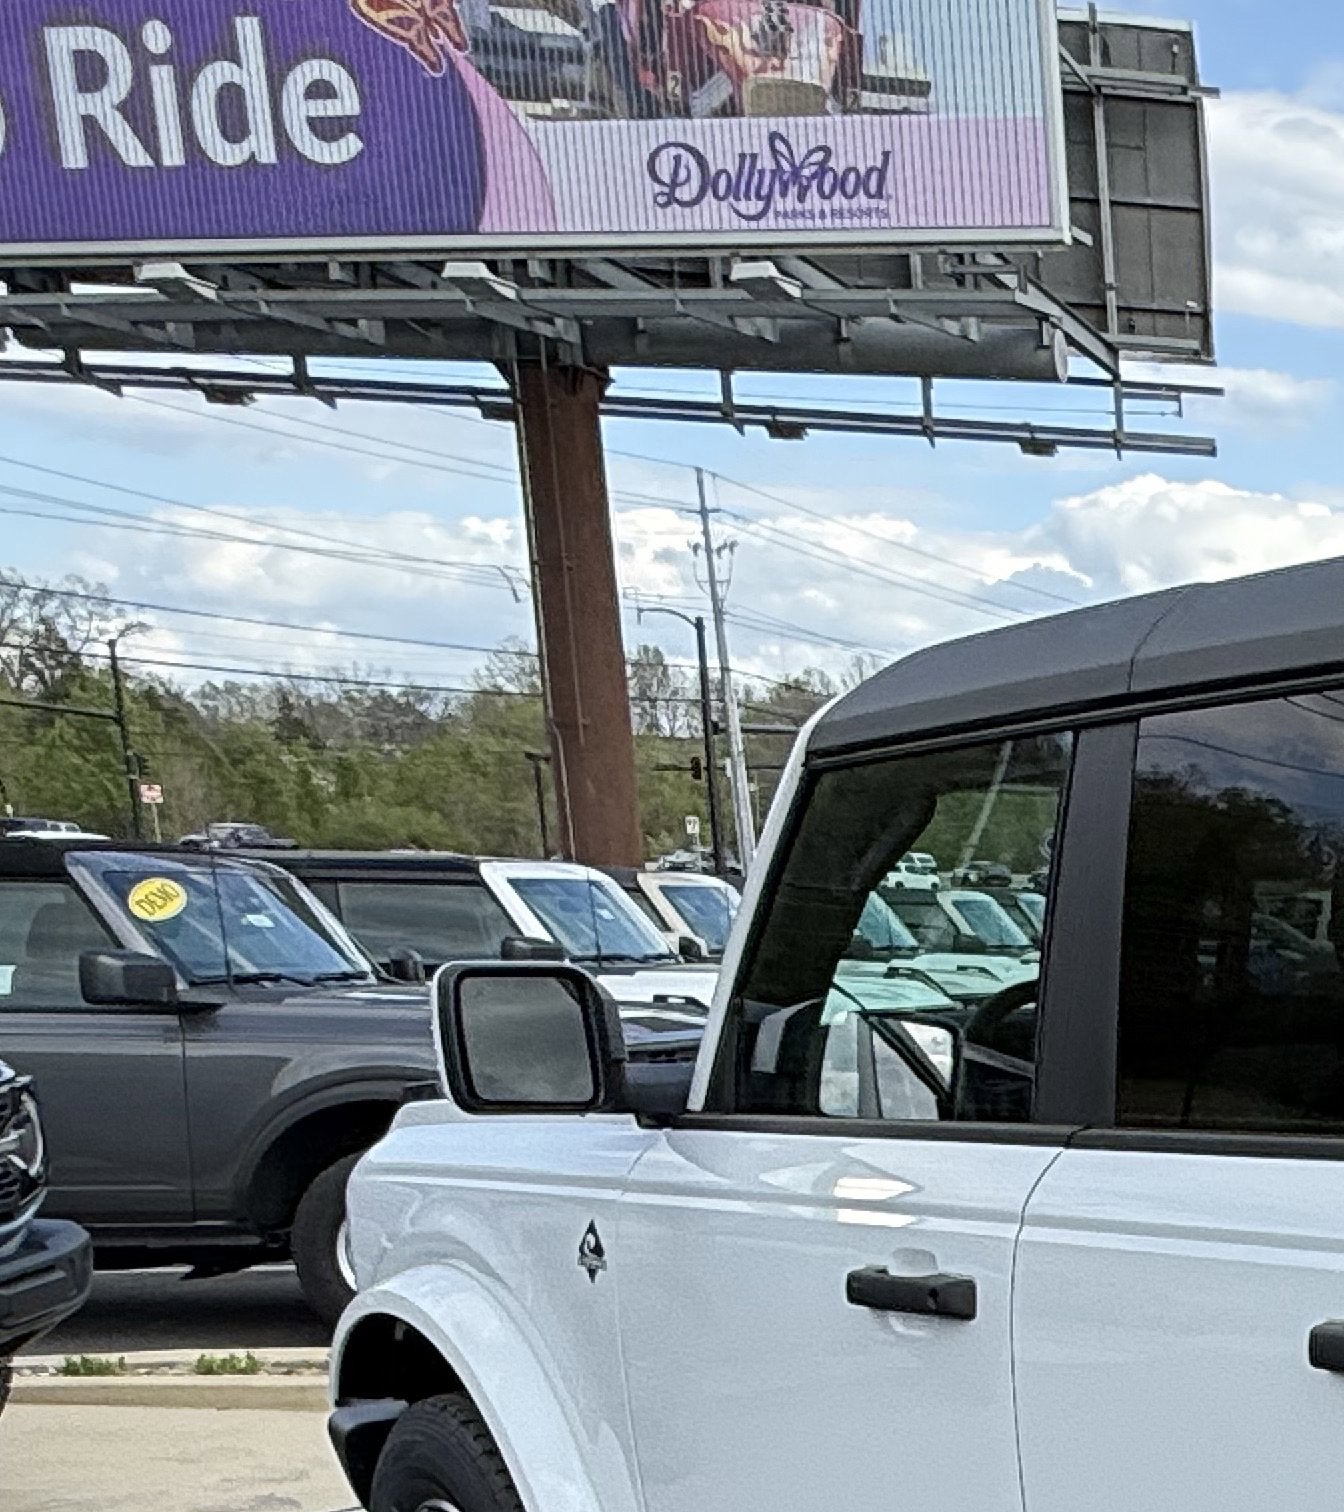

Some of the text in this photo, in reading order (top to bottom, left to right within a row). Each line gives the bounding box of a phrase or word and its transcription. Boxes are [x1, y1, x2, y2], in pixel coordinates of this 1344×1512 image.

[43, 16, 364, 169] Ride
[647, 131, 892, 221] Dollywood
[135, 882, 180, 916] DEMO
